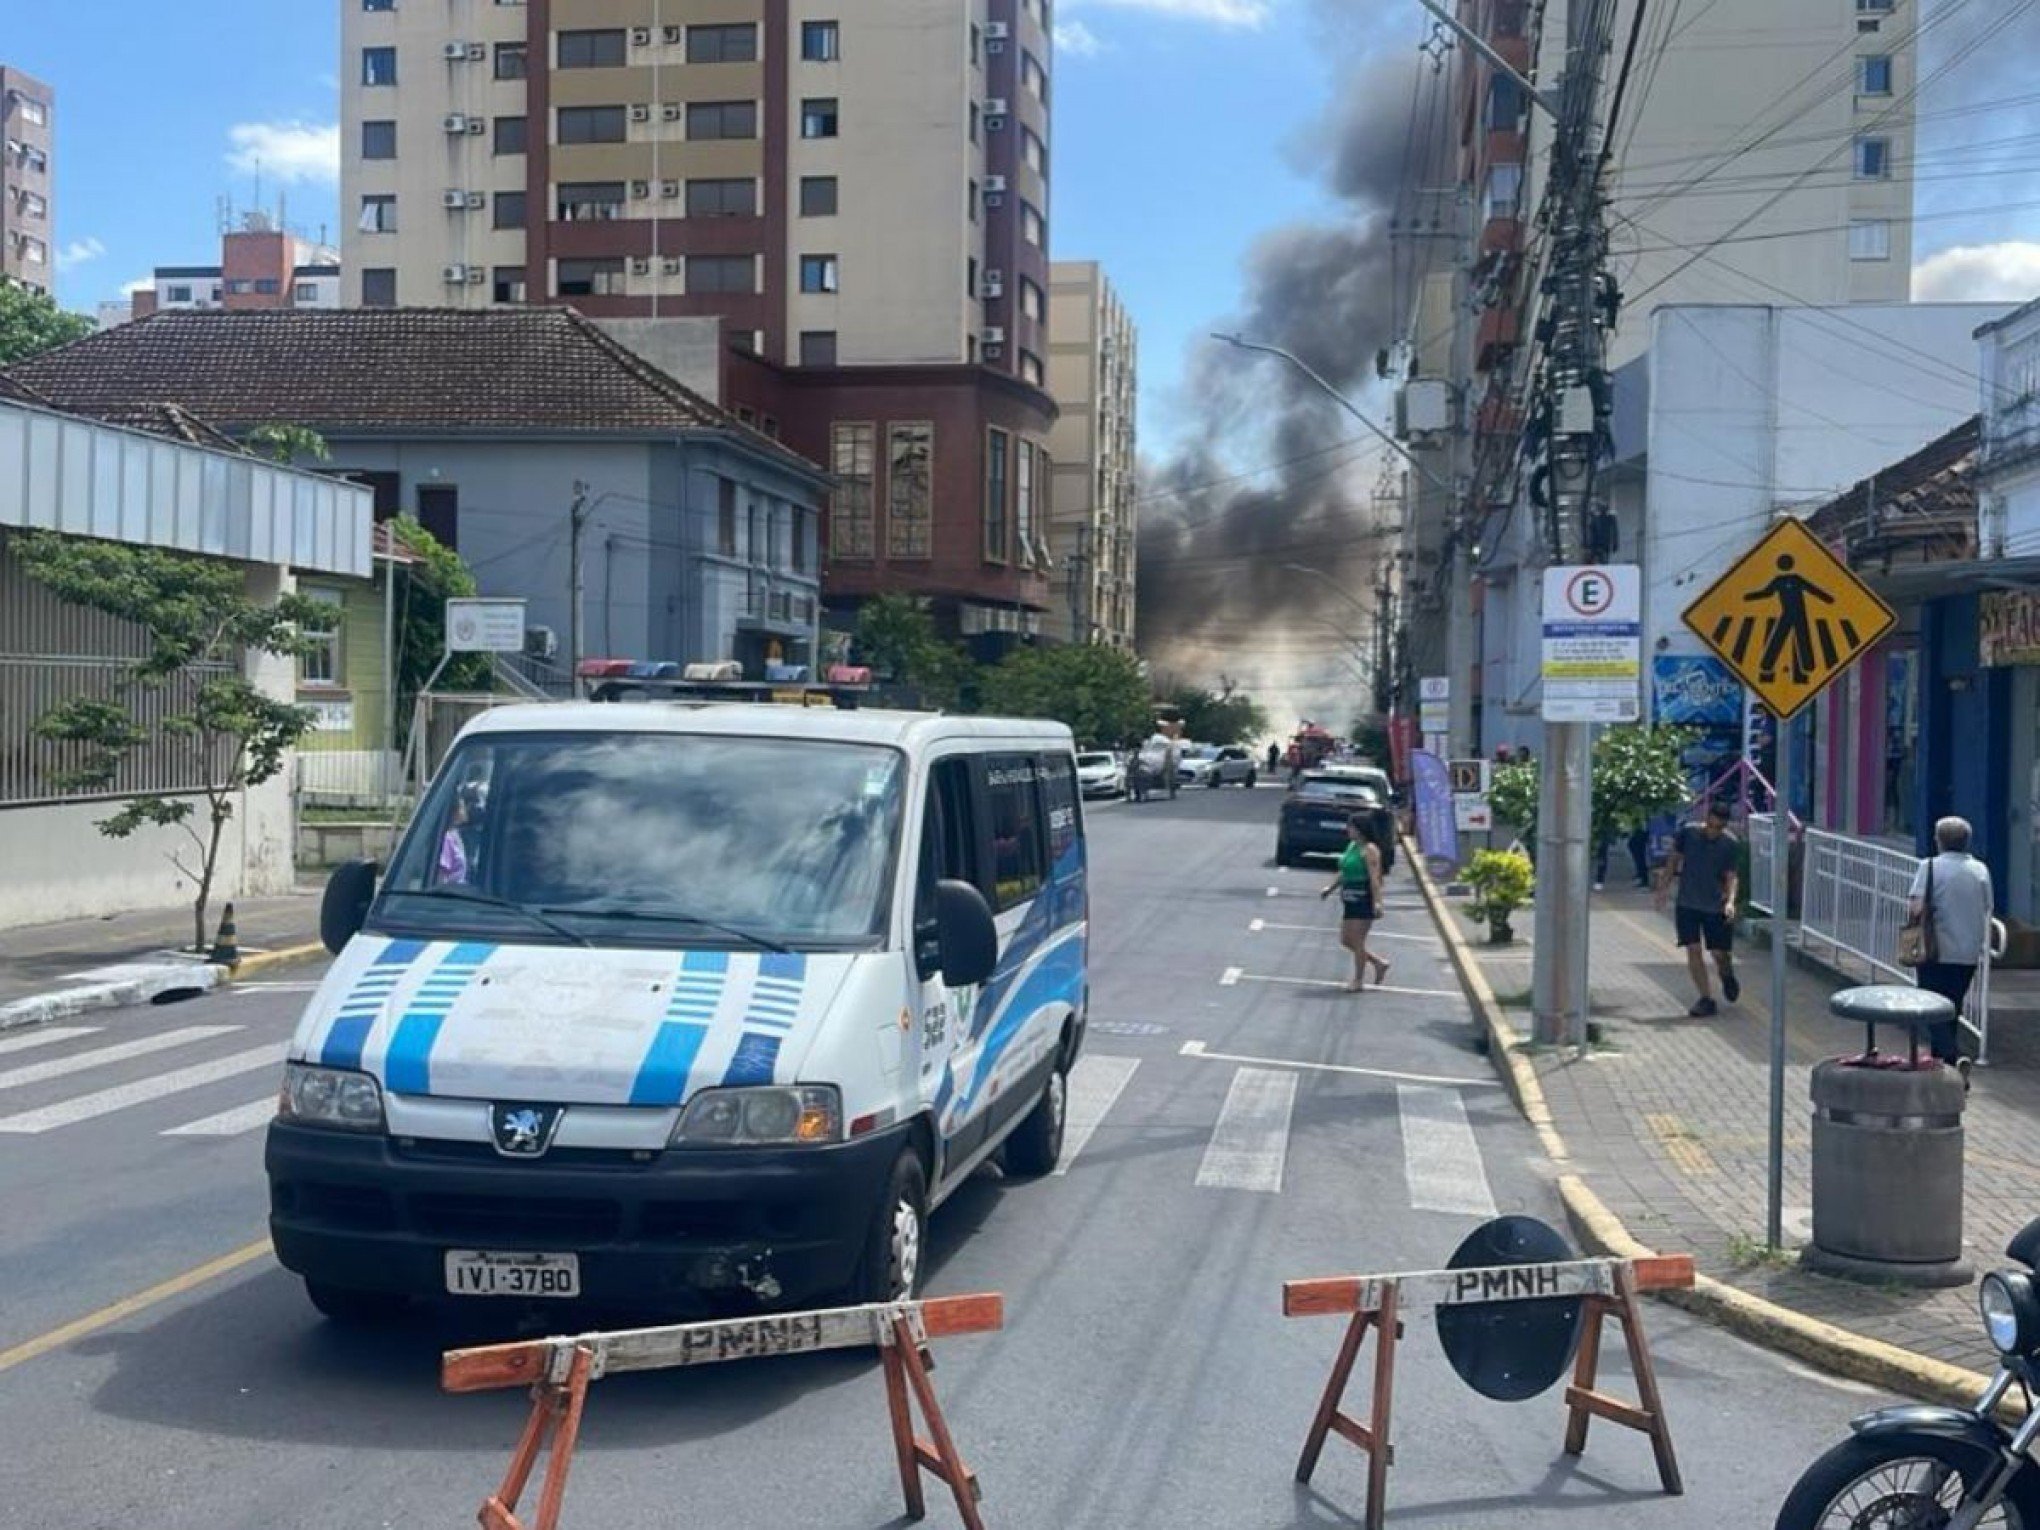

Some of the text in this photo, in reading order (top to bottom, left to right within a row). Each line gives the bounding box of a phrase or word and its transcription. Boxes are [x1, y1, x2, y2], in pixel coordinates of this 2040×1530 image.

[1581, 579, 1599, 606] E
[1455, 1265, 1559, 1301] PMNH
[679, 1313, 822, 1364] PMNH
